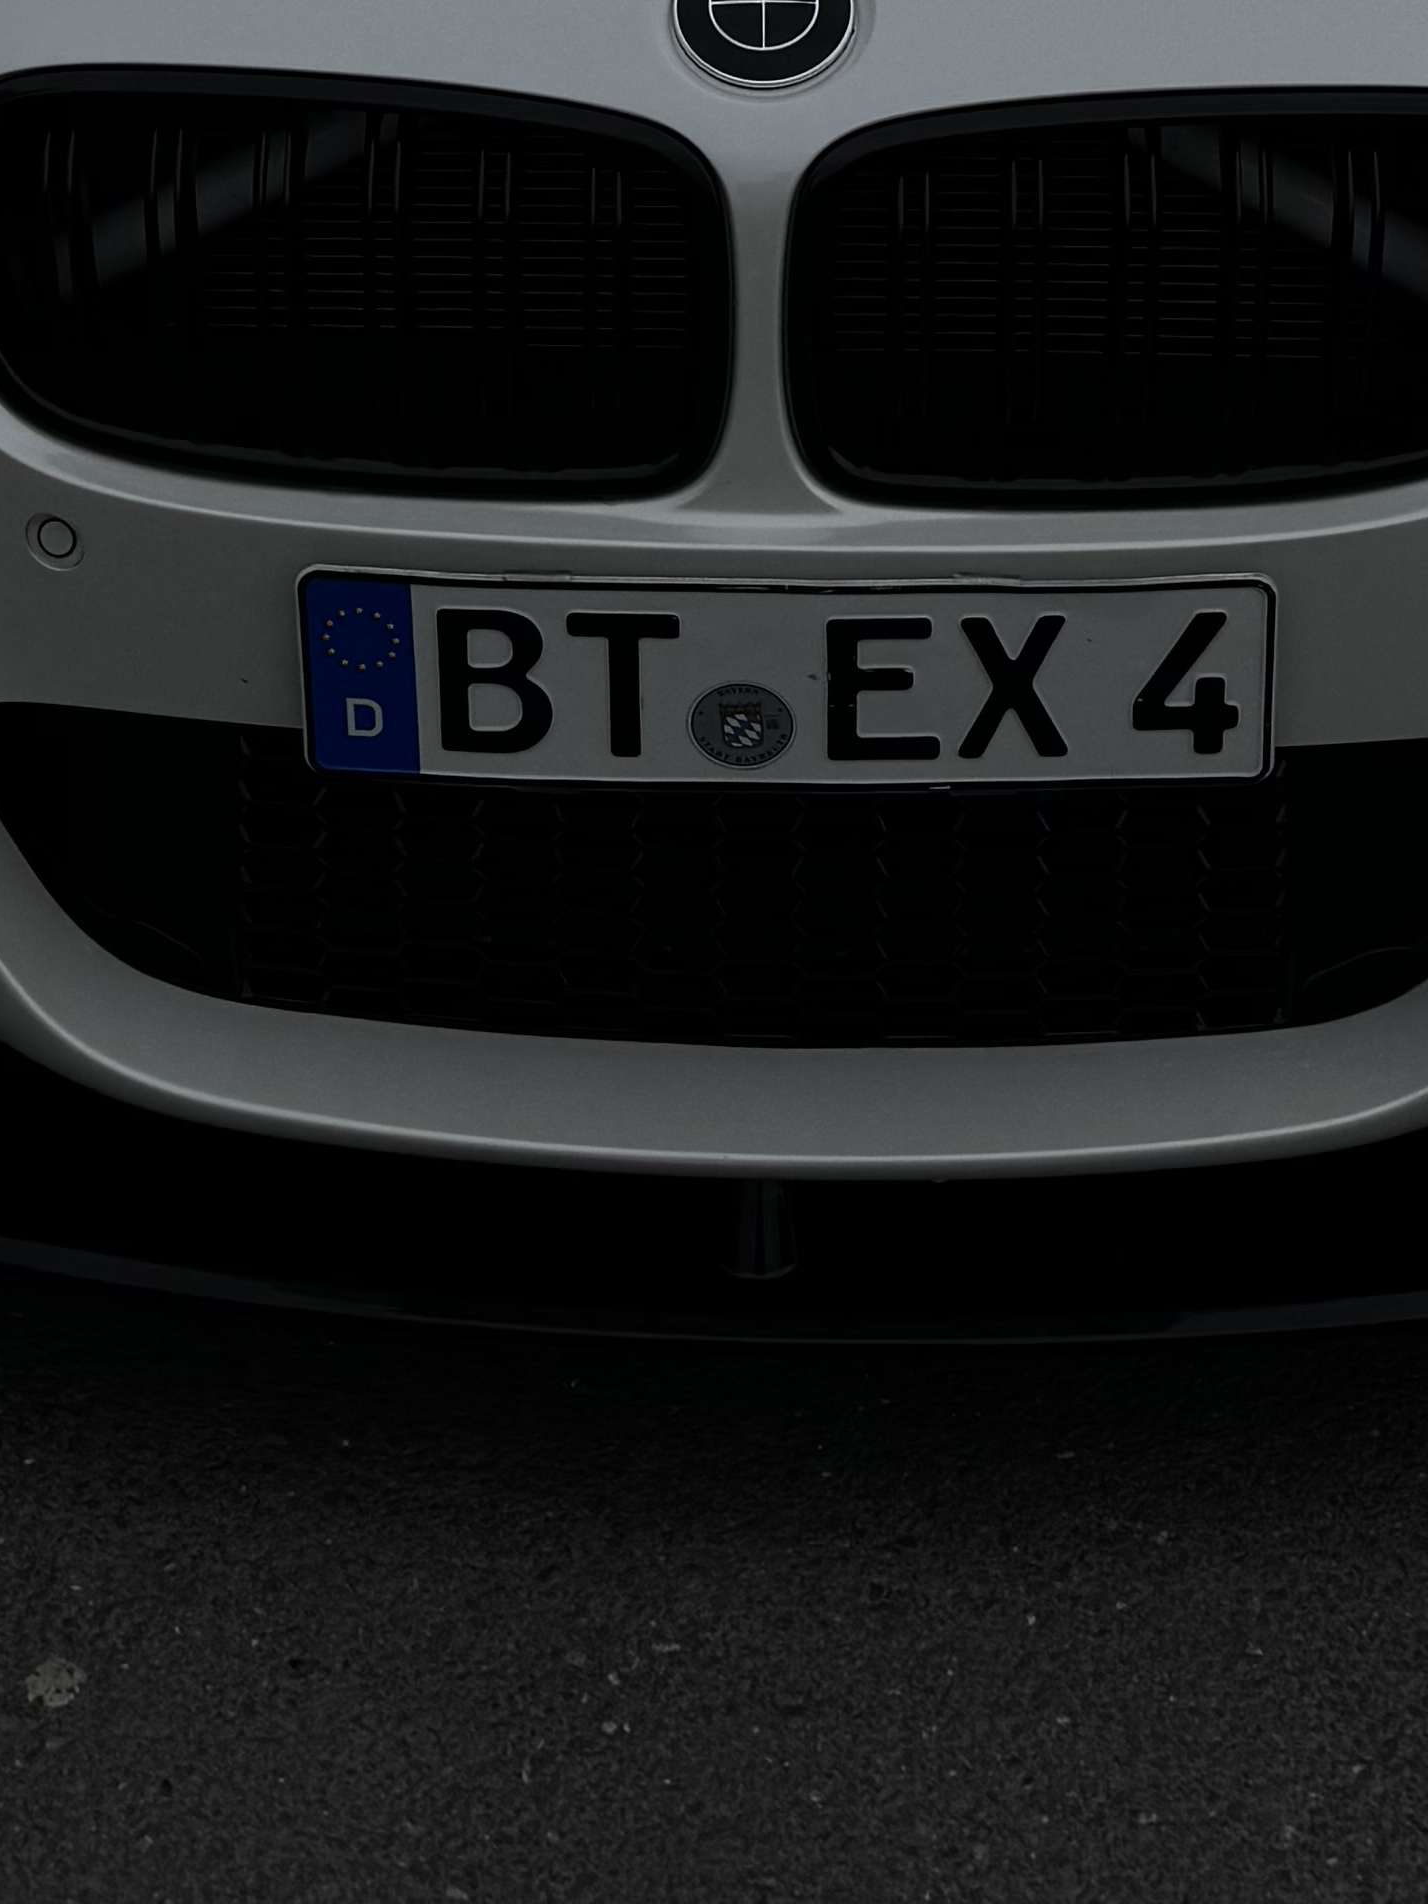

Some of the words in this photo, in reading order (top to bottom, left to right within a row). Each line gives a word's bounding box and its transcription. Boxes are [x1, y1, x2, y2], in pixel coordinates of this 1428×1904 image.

[345, 696, 384, 738] D
[436, 608, 680, 758] BT
[826, 616, 1069, 761] EX
[1132, 612, 1241, 755] 4
